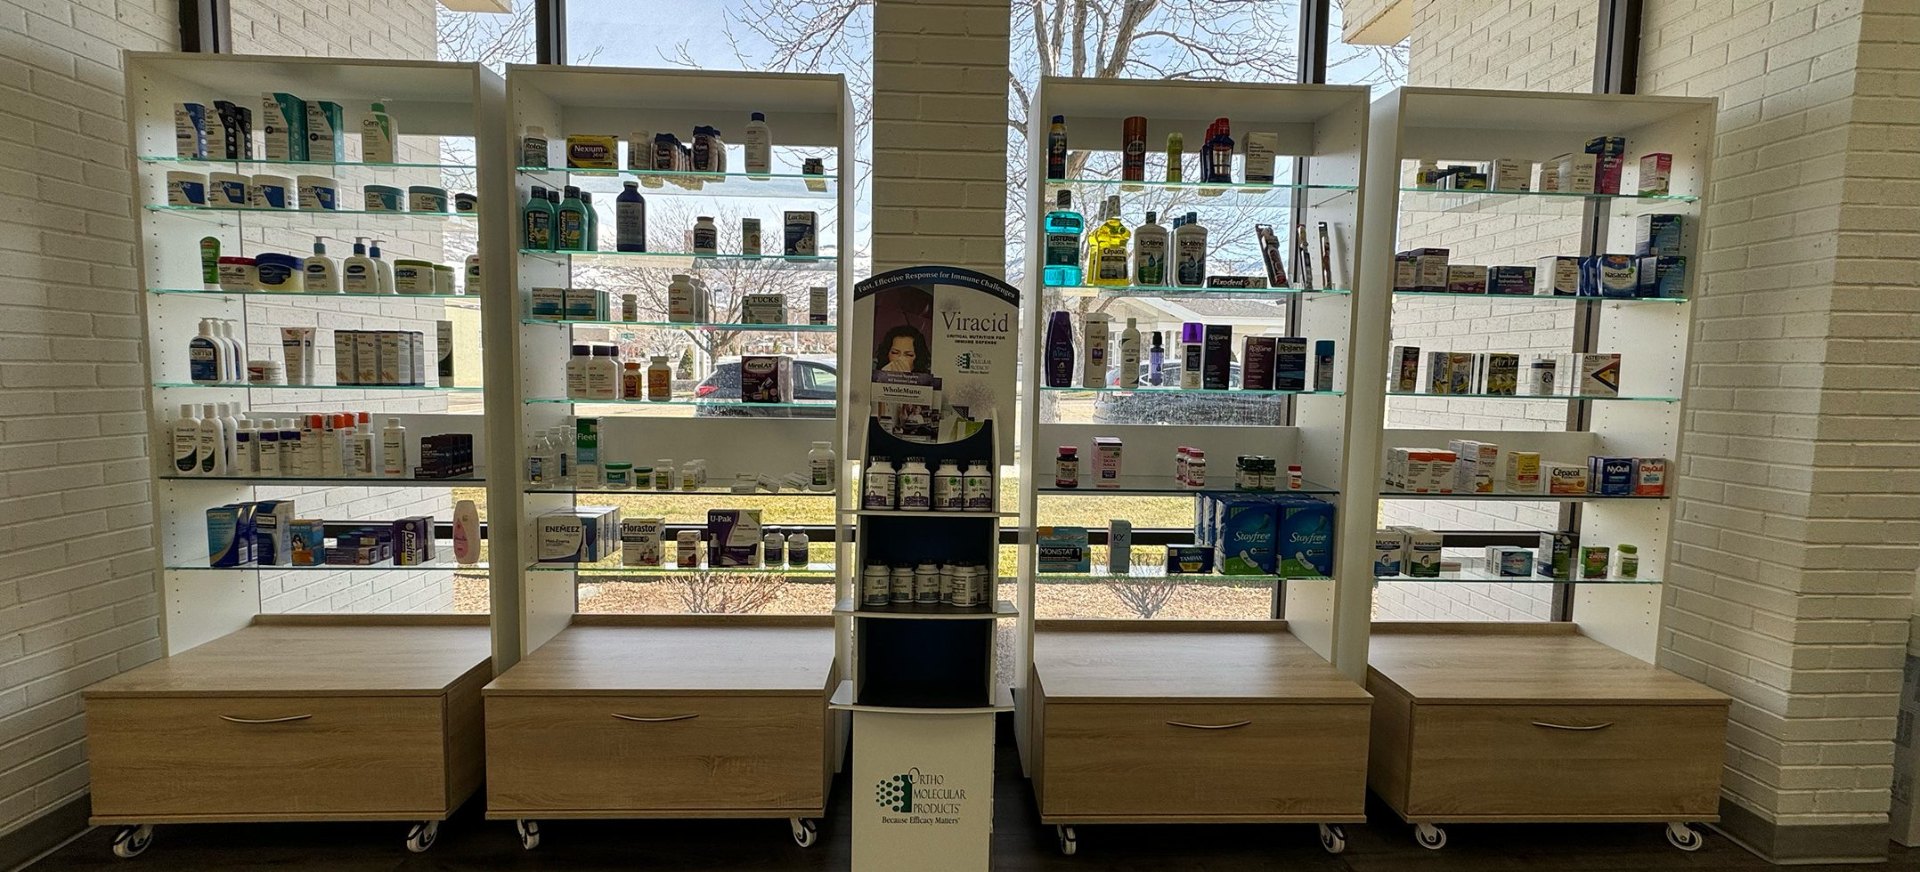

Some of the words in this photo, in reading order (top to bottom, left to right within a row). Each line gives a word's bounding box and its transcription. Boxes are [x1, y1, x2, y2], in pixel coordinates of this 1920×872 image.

[574, 144, 604, 153] Nexium
[1604, 269, 1632, 279] Nasacort
[858, 283, 875, 295] Fast,
[875, 275, 905, 287] Effective
[905, 272, 939, 282] Response
[939, 270, 951, 279] for
[950, 273, 981, 285] Immune
[980, 278, 1016, 298] Challenges
[1212, 278, 1243, 287] Fixodent
[752, 296, 780, 304] TUCKS
[941, 311, 1009, 333] Viracid
[1280, 343, 1305, 353] Rogaine
[577, 432, 597, 441] Fleet
[1552, 467, 1580, 480] Cépacol
[1606, 464, 1630, 475] NyQuil
[1641, 465, 1664, 475] DayQuil
[710, 514, 733, 523] U-Pak
[622, 522, 657, 534] Florastor
[1233, 531, 1271, 544] Stayfree
[1289, 532, 1327, 545] Stayfree
[1040, 548, 1074, 556] MONISTAT
[908, 767, 944, 785] ORTHO
[913, 789, 967, 800] MOLECULAR
[909, 816, 933, 825] Efficacy
